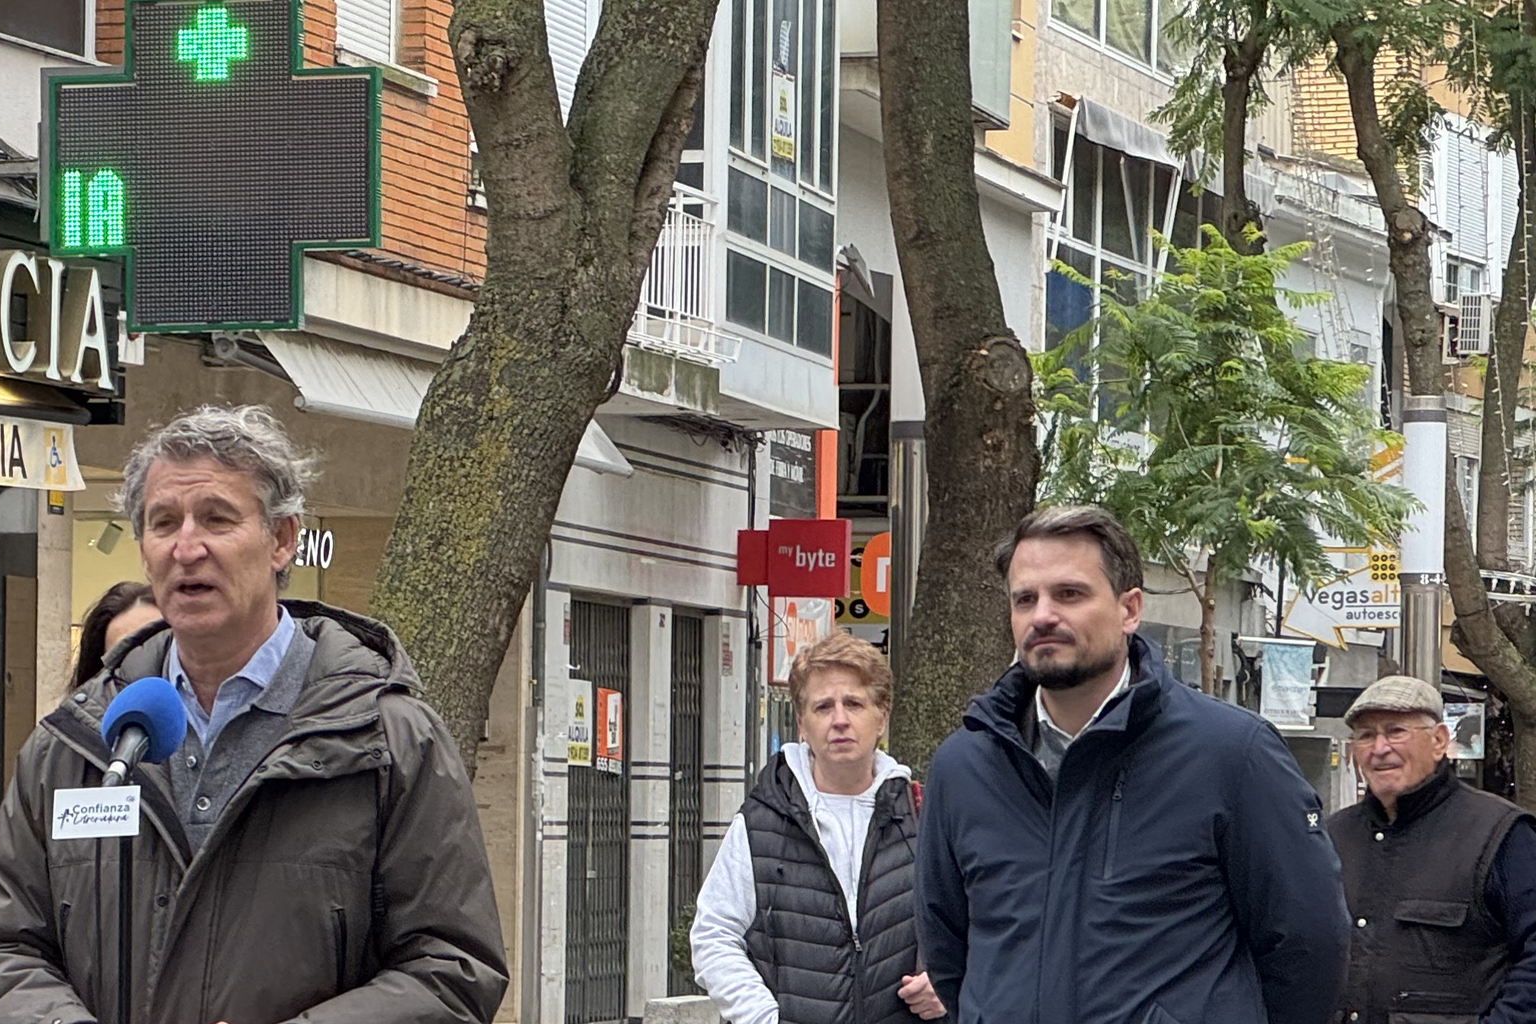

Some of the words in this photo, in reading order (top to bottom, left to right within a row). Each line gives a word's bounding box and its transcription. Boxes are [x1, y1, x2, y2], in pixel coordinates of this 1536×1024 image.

[64, 170, 124, 247] IA
[778, 545, 793, 557] my
[796, 545, 836, 572] byte
[1345, 608, 1400, 620] autoesc
[72, 803, 131, 816] Confianza
